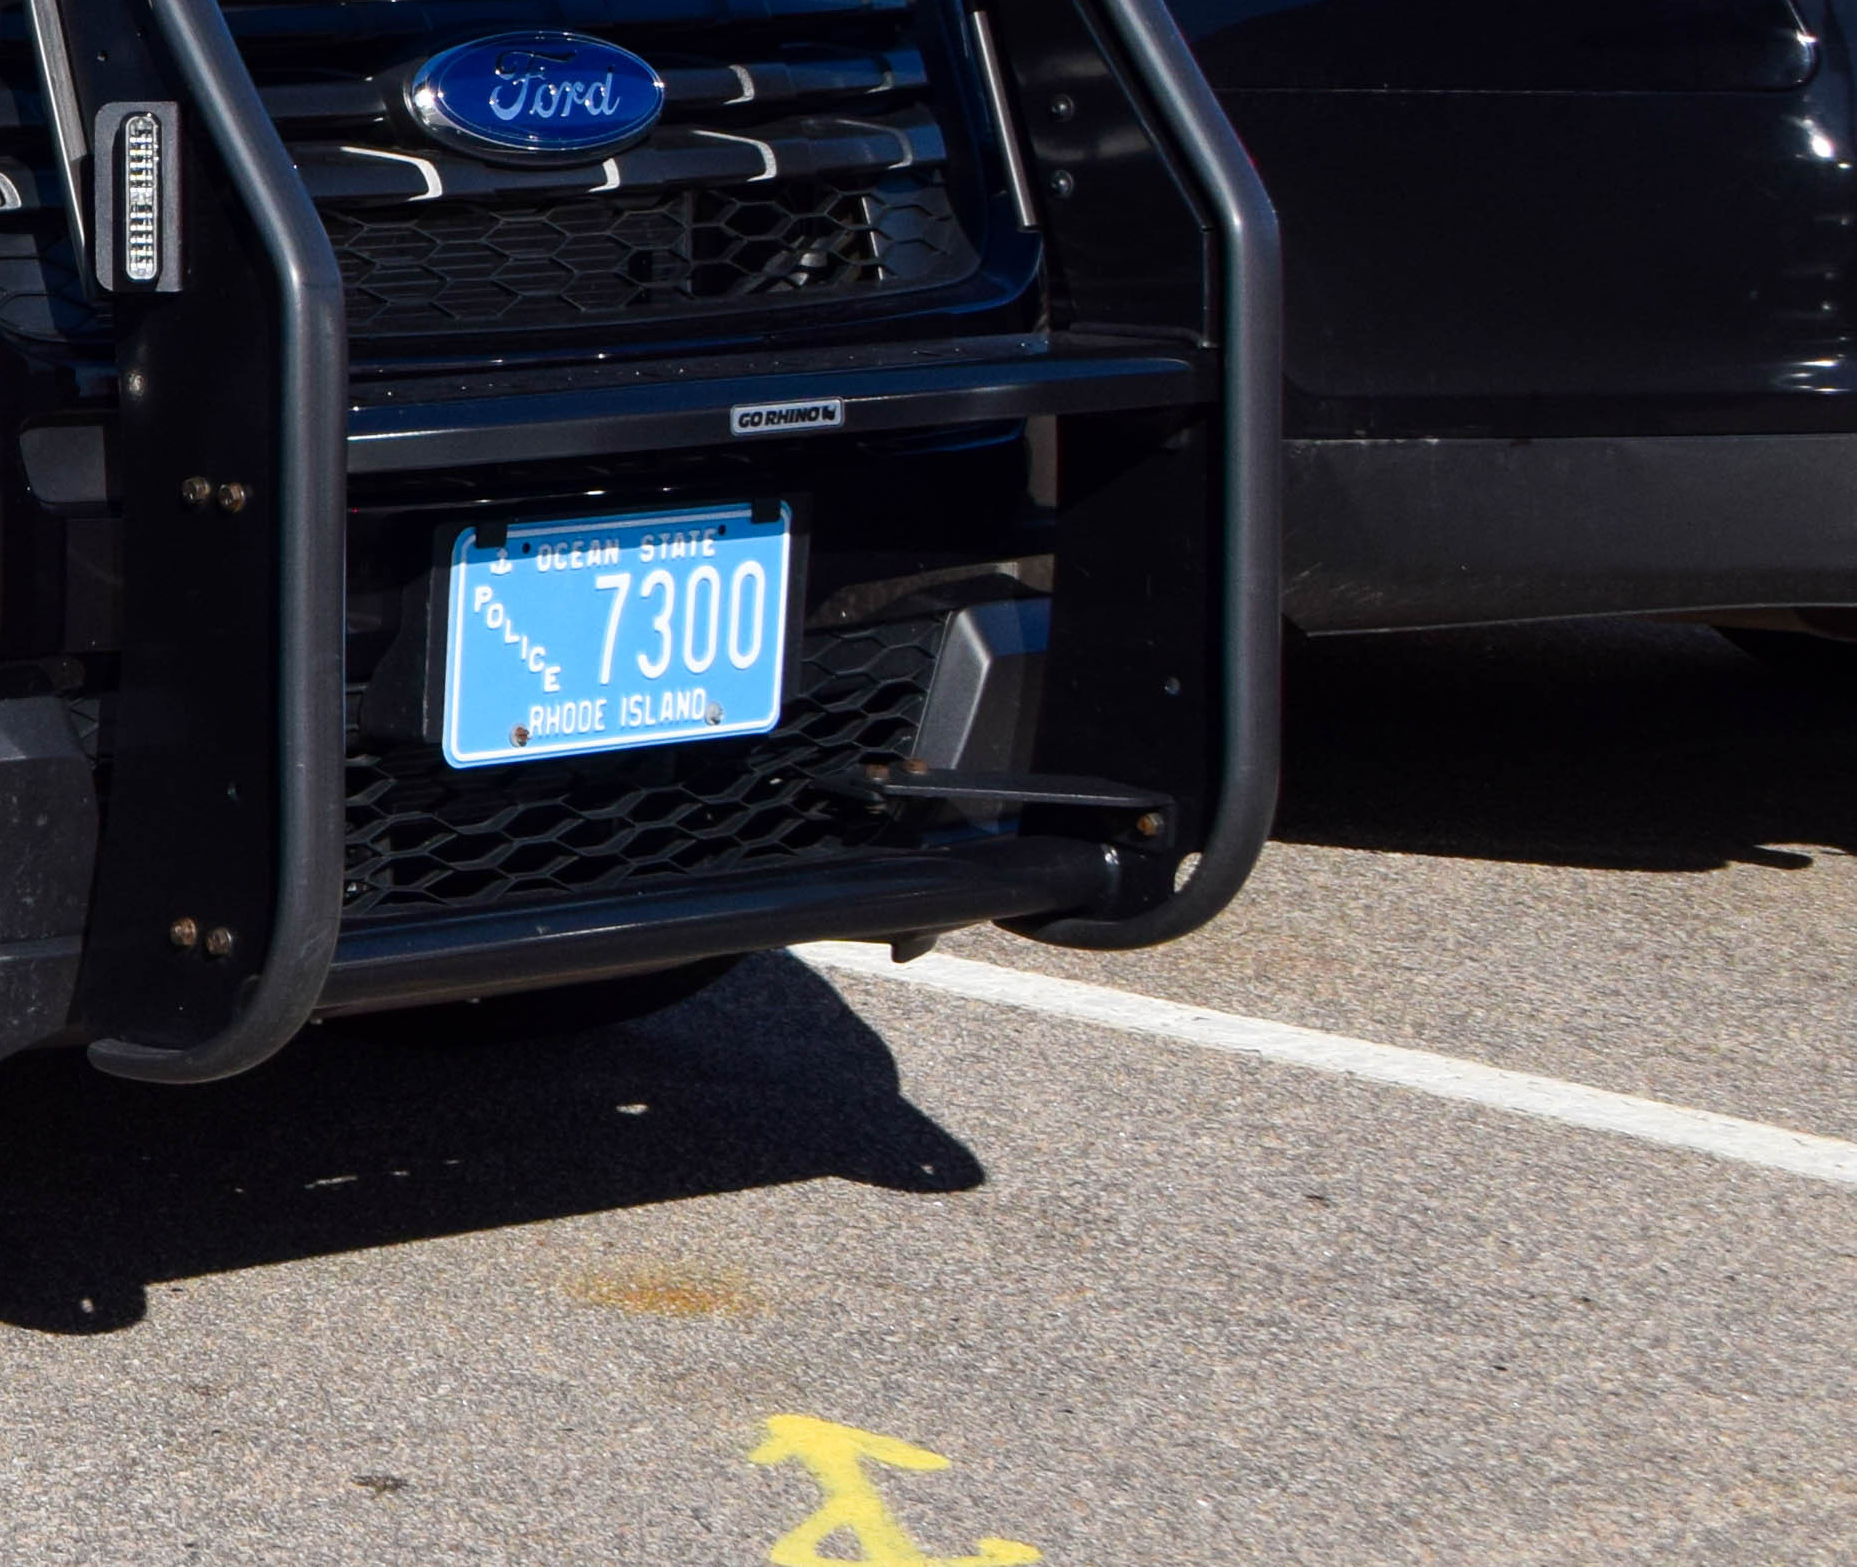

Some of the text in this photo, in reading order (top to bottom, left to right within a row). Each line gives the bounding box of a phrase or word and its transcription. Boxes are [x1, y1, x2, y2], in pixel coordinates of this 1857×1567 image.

[490, 50, 621, 121] Ford
[537, 527, 717, 573] OCEAN STATE
[474, 585, 562, 692] POLICE
[595, 561, 765, 684] 7300
[529, 687, 707, 732] RHODE ISLAND
